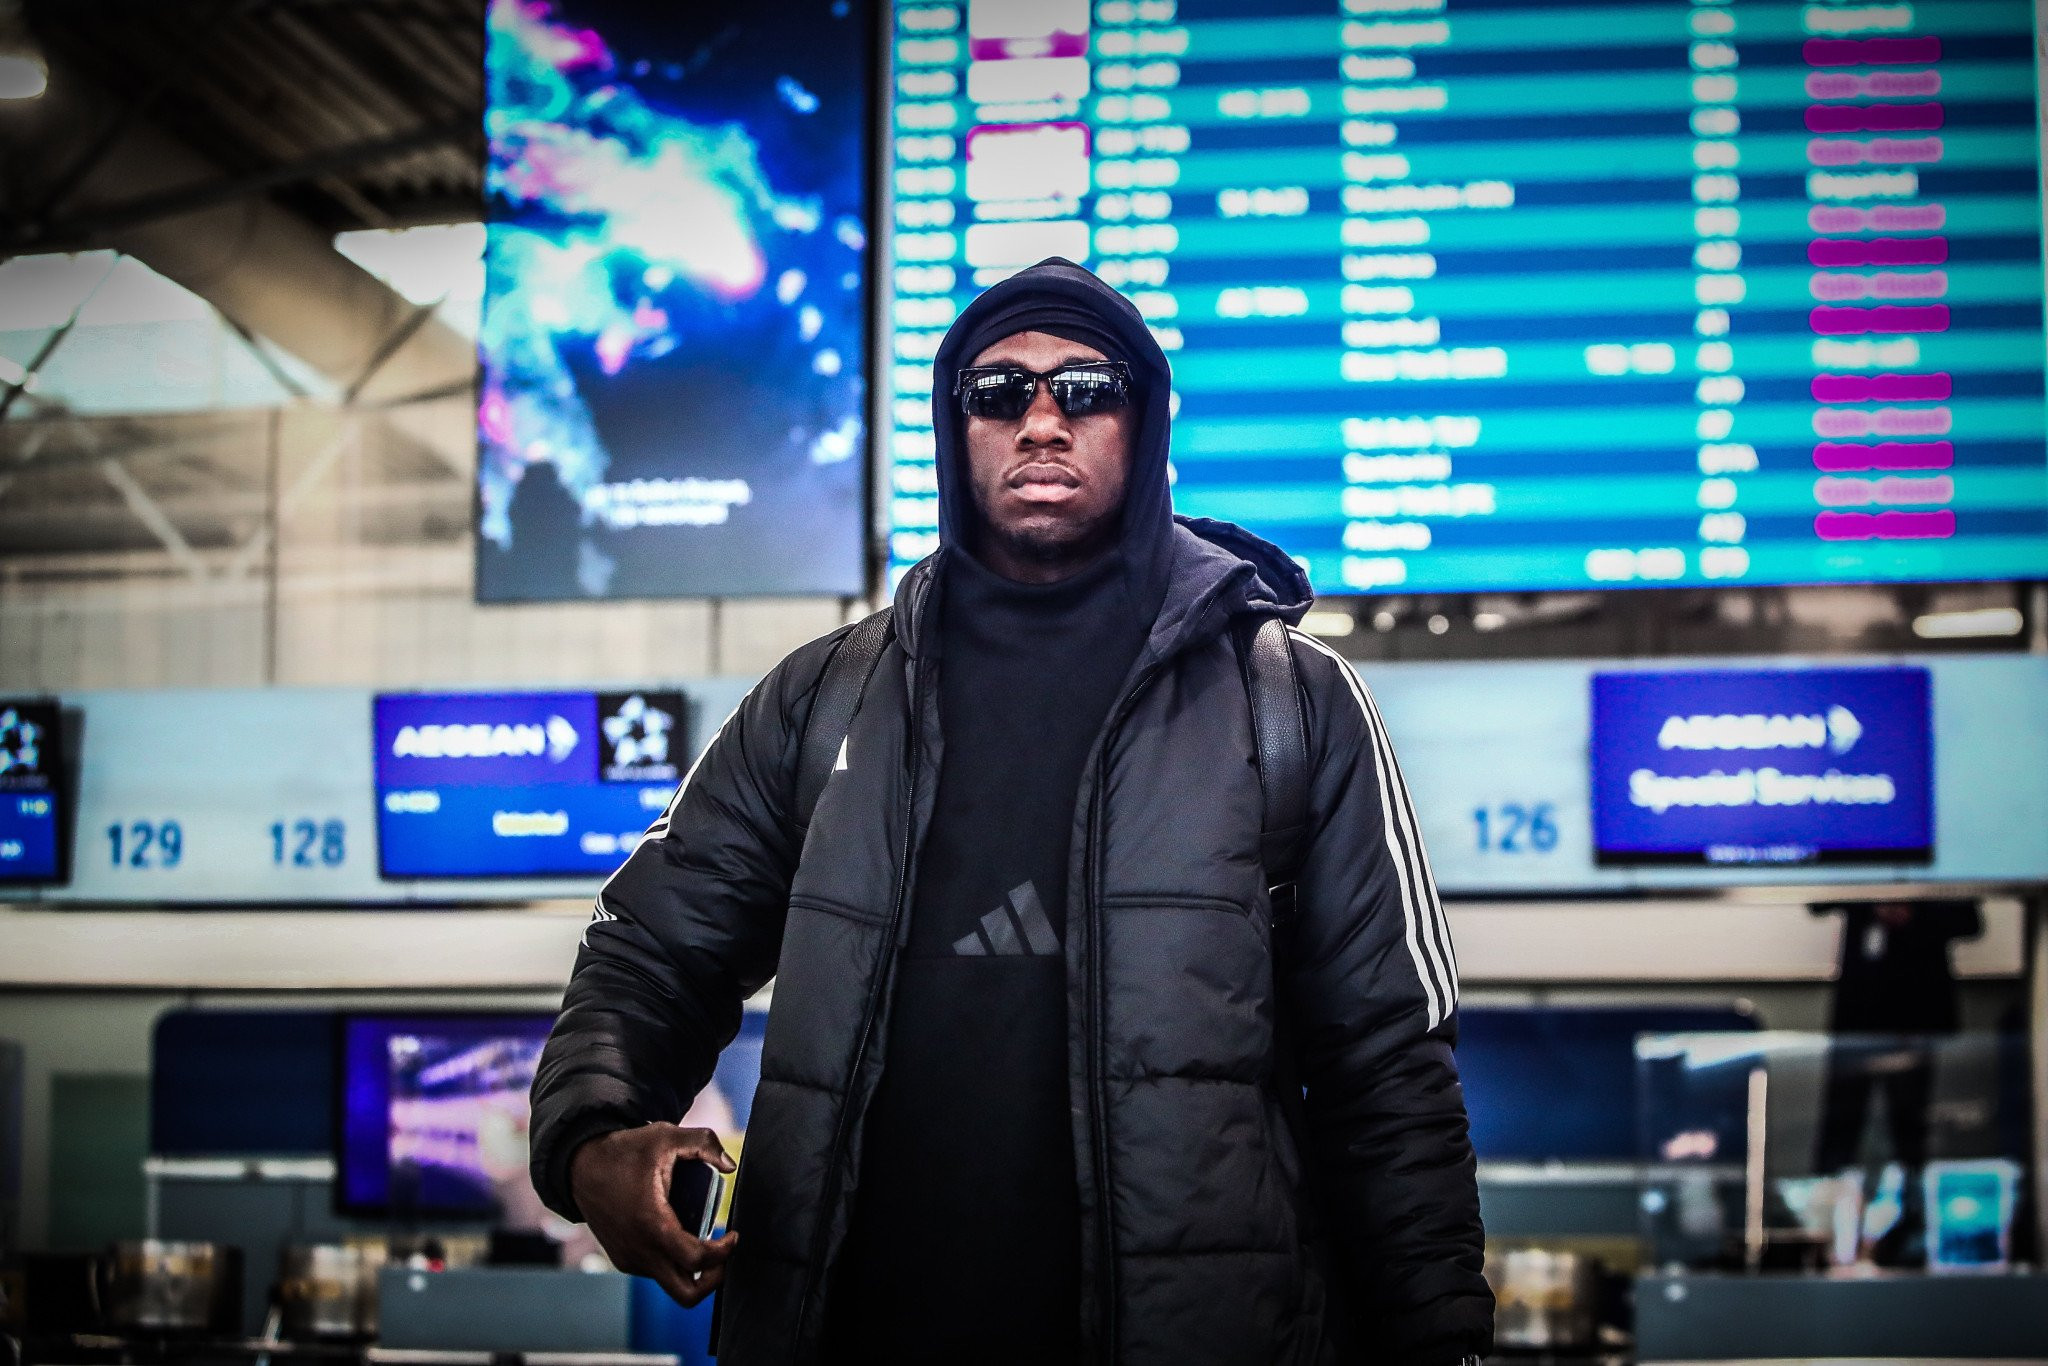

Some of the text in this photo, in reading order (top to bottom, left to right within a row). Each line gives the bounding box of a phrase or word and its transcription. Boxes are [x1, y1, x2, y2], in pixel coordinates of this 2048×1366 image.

[107, 819, 183, 868] 129
[269, 818, 346, 868] 128
[1472, 803, 1559, 853] 126
